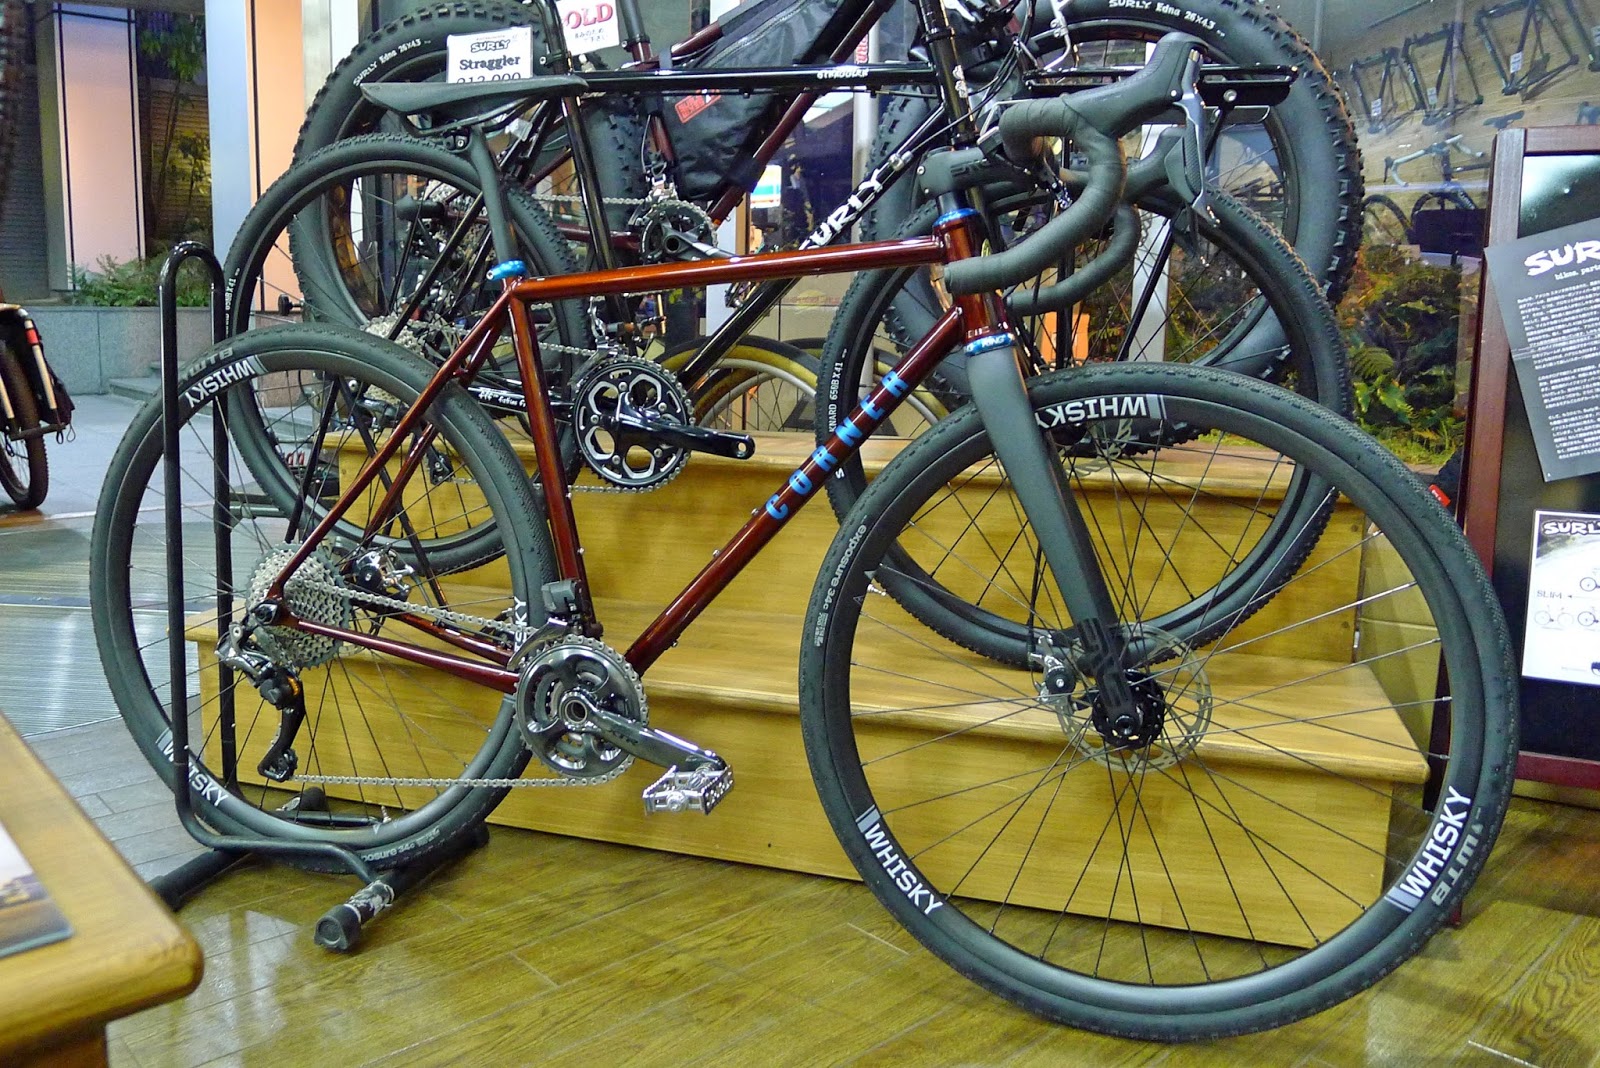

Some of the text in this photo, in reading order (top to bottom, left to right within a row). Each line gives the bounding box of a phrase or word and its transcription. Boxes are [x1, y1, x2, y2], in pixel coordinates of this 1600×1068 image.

[563, 3, 613, 29] OLD
[1155, 3, 1181, 16] Edna
[470, 39, 510, 53] SURLY
[353, 61, 378, 86] SURLY
[460, 55, 521, 70] Straggler
[184, 359, 255, 408] WHISKY
[828, 403, 838, 433] KNARD
[1034, 396, 1147, 429] WHISKY
[765, 370, 909, 520] CORNER
[823, 524, 867, 610] exposure 34c
[1400, 785, 1471, 899] WHISKY
[864, 822, 943, 915] WHISKY
